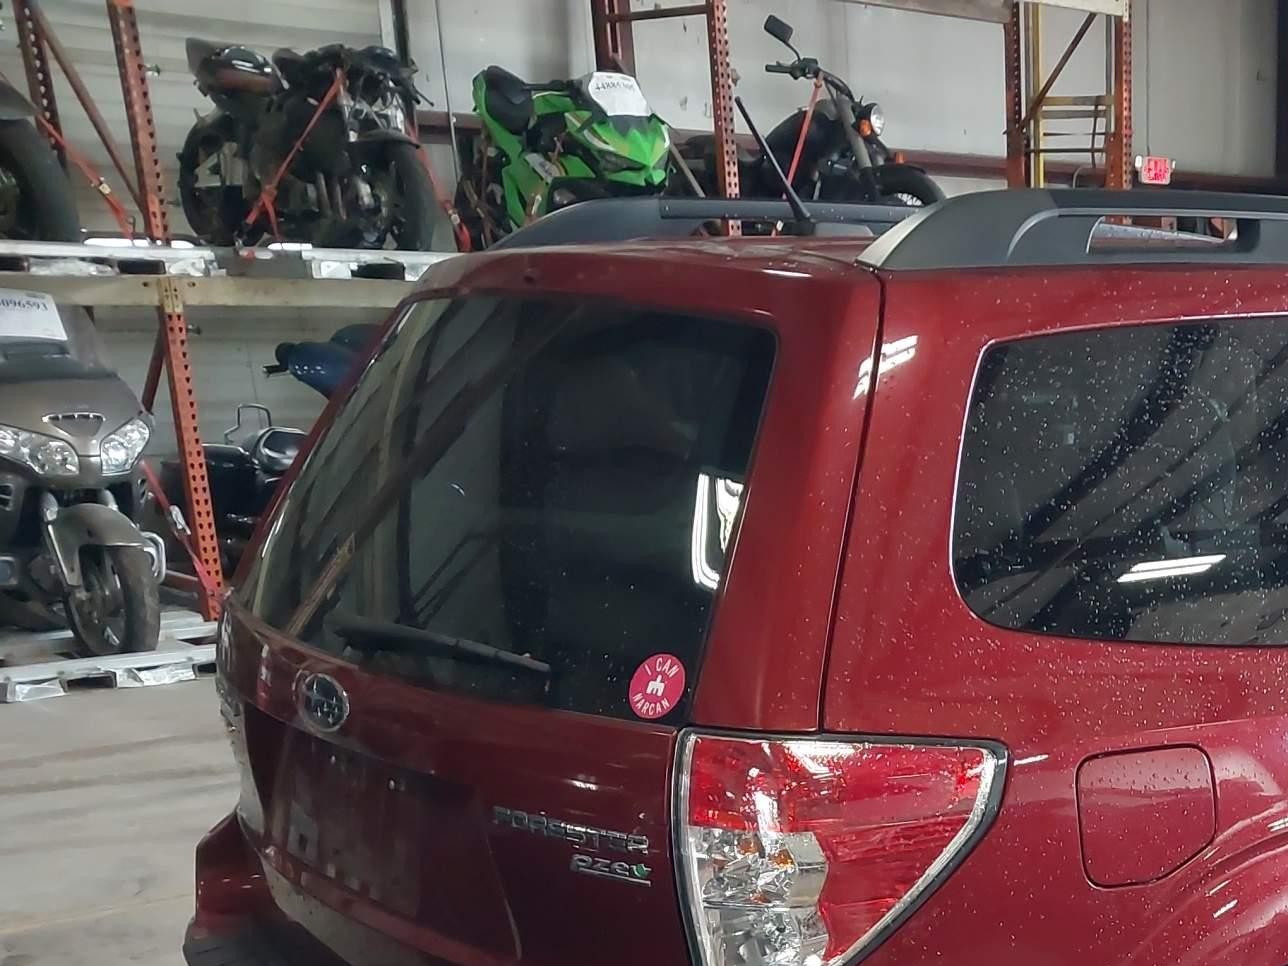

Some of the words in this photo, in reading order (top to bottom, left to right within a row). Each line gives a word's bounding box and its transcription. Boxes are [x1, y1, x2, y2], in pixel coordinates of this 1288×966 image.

[644, 663, 652, 676] I
[655, 657, 680, 678] CAN
[632, 692, 671, 716] NARCAN
